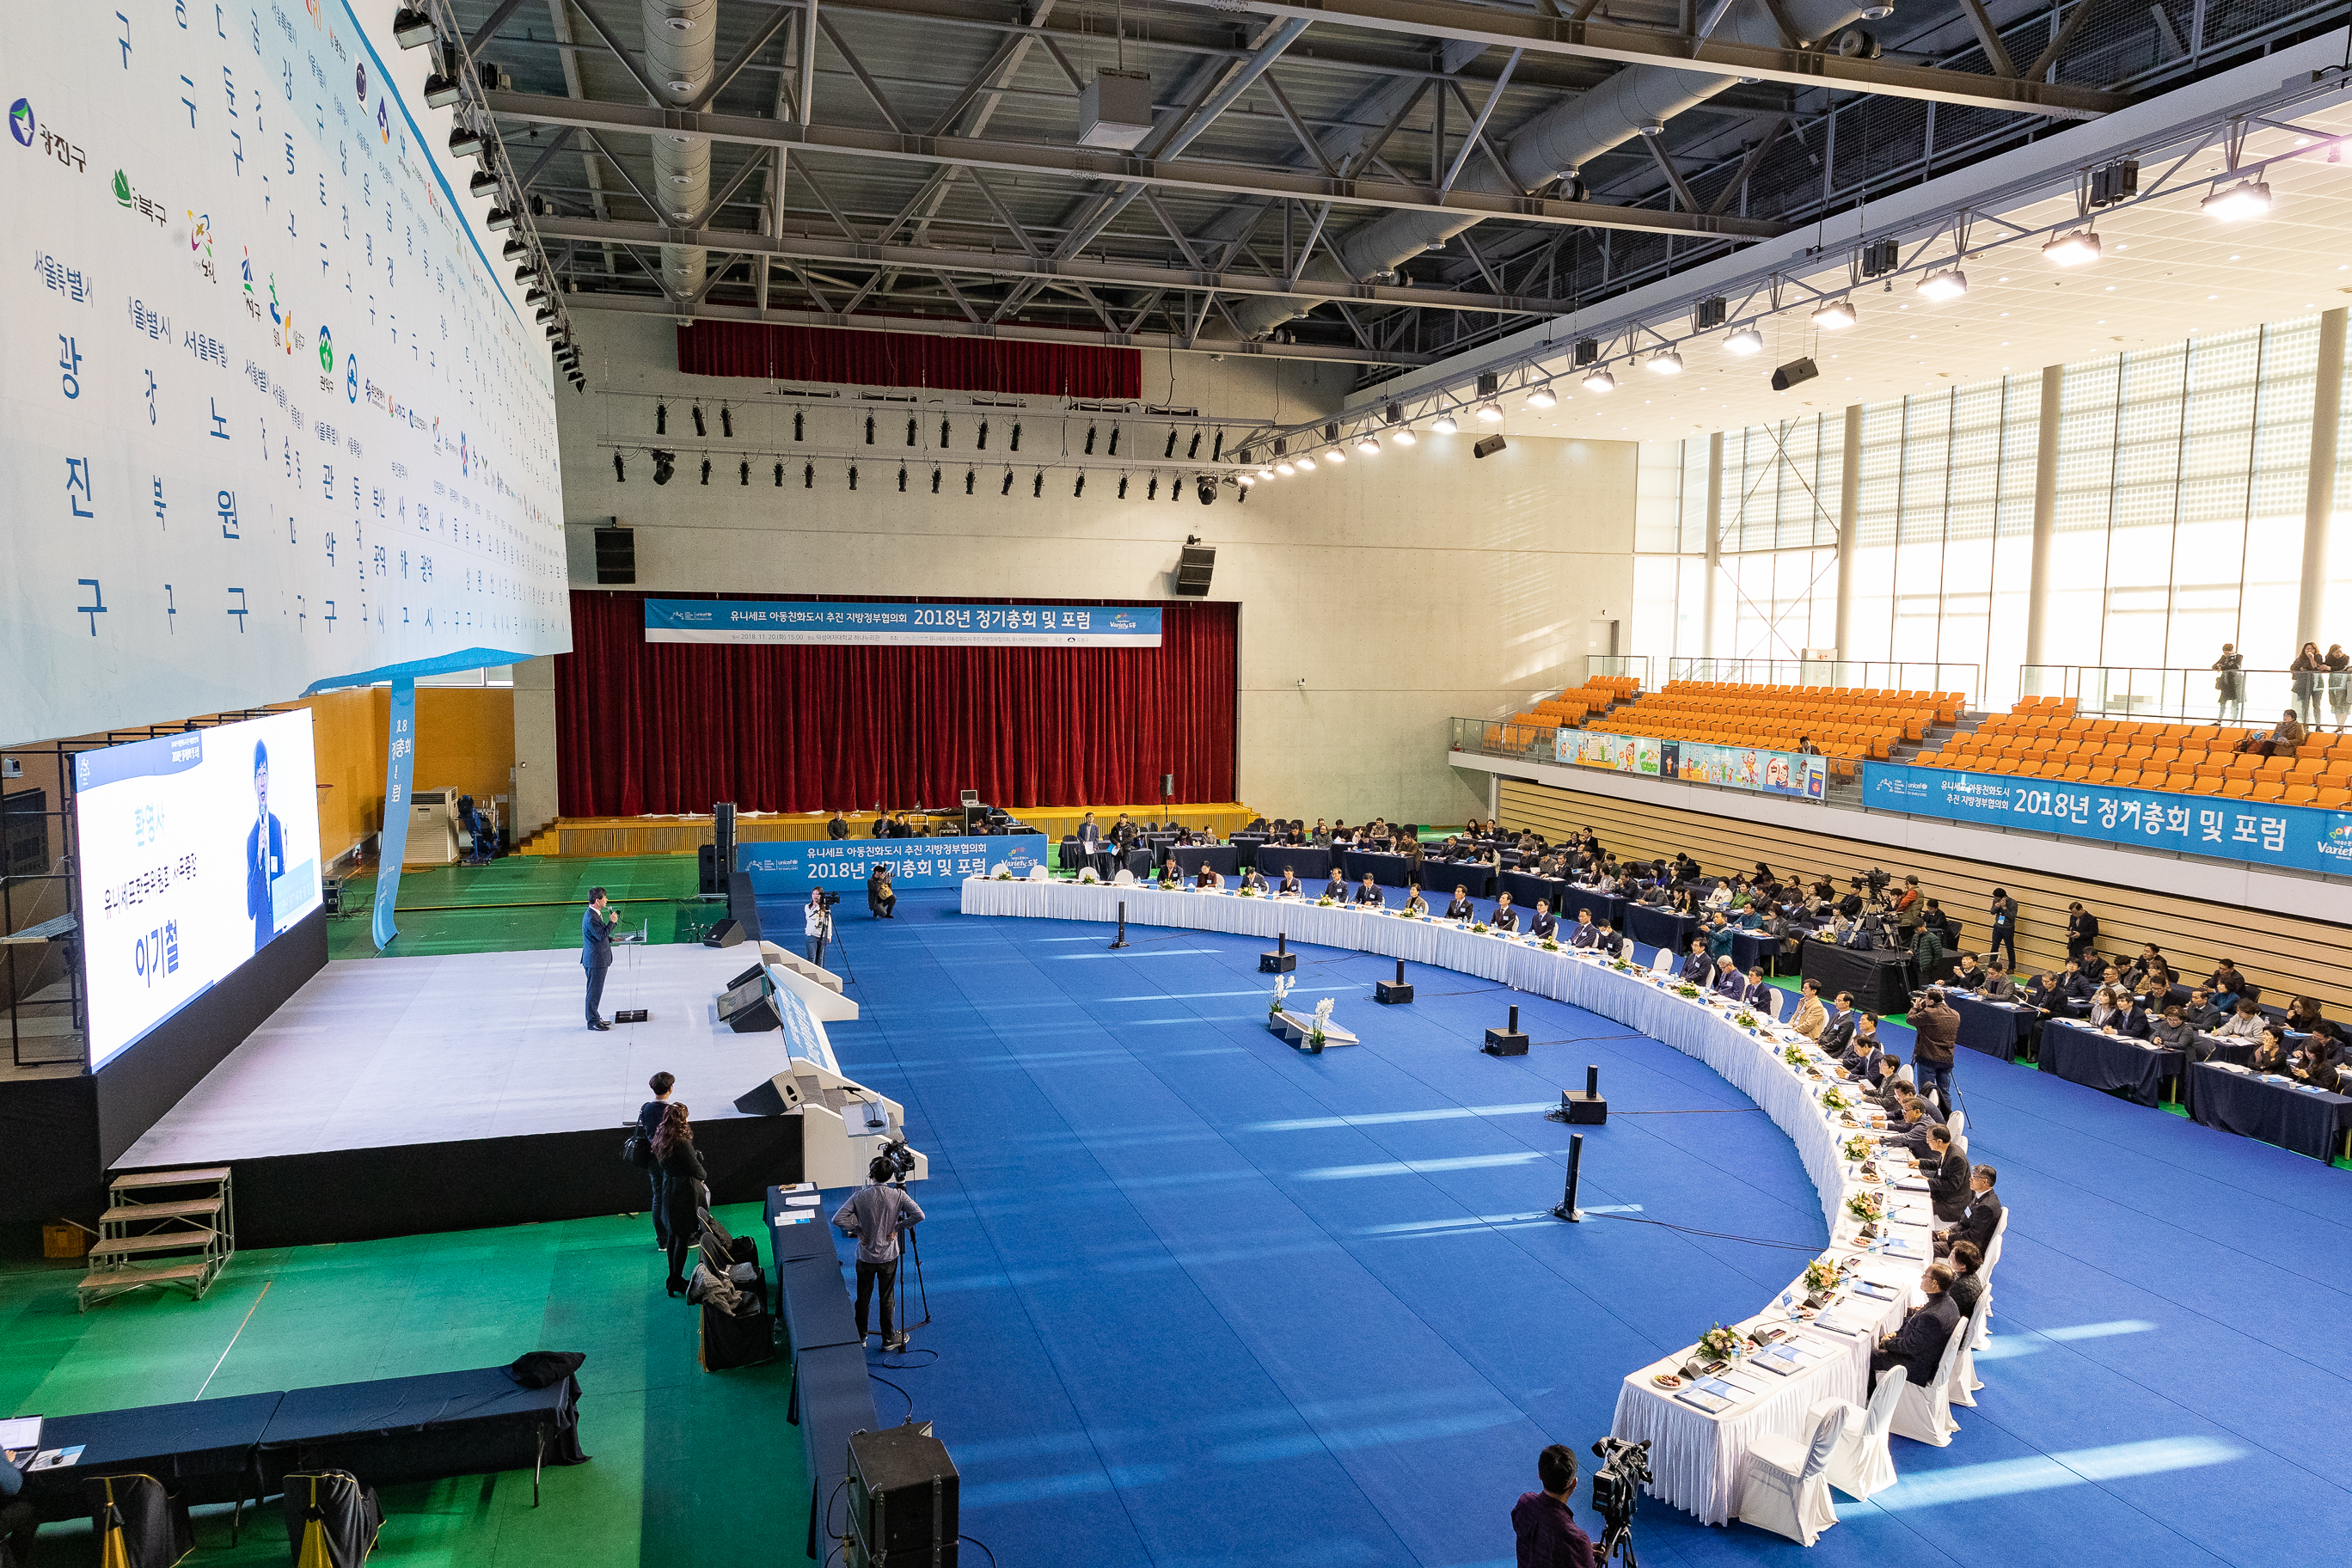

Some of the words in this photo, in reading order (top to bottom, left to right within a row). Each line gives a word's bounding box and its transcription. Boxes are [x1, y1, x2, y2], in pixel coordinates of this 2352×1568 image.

[731, 611, 768, 622] 유니세프
[769, 611, 824, 622] 아동친화도시
[826, 612, 844, 623] 추진
[846, 612, 908, 624] 지방정부협의회
[914, 609, 971, 628] 2018년
[976, 609, 1037, 629] 정기총회
[1042, 611, 1057, 629] 및
[1061, 611, 1091, 630] 포럼
[1940, 780, 1967, 792] 유니세프
[1969, 783, 2011, 798] 아동친화도시
[1946, 793, 1960, 805] 추진
[1961, 794, 2009, 811] 지방정부협의회
[2013, 788, 2090, 824] 2018년
[2097, 796, 2191, 836] 정기총회
[2200, 810, 2223, 843] 및
[2232, 814, 2287, 852] 포럼
[807, 845, 843, 859] 유니세프
[846, 844, 903, 858] 아동친화도시
[904, 844, 922, 857] 추진
[925, 842, 987, 855] 지방정부협의회
[807, 861, 866, 879] 2018년
[937, 858, 952, 876] 및
[957, 857, 986, 877] 포럼
[1001, 860, 1027, 869] Variety
[135, 918, 179, 989] 이기철
